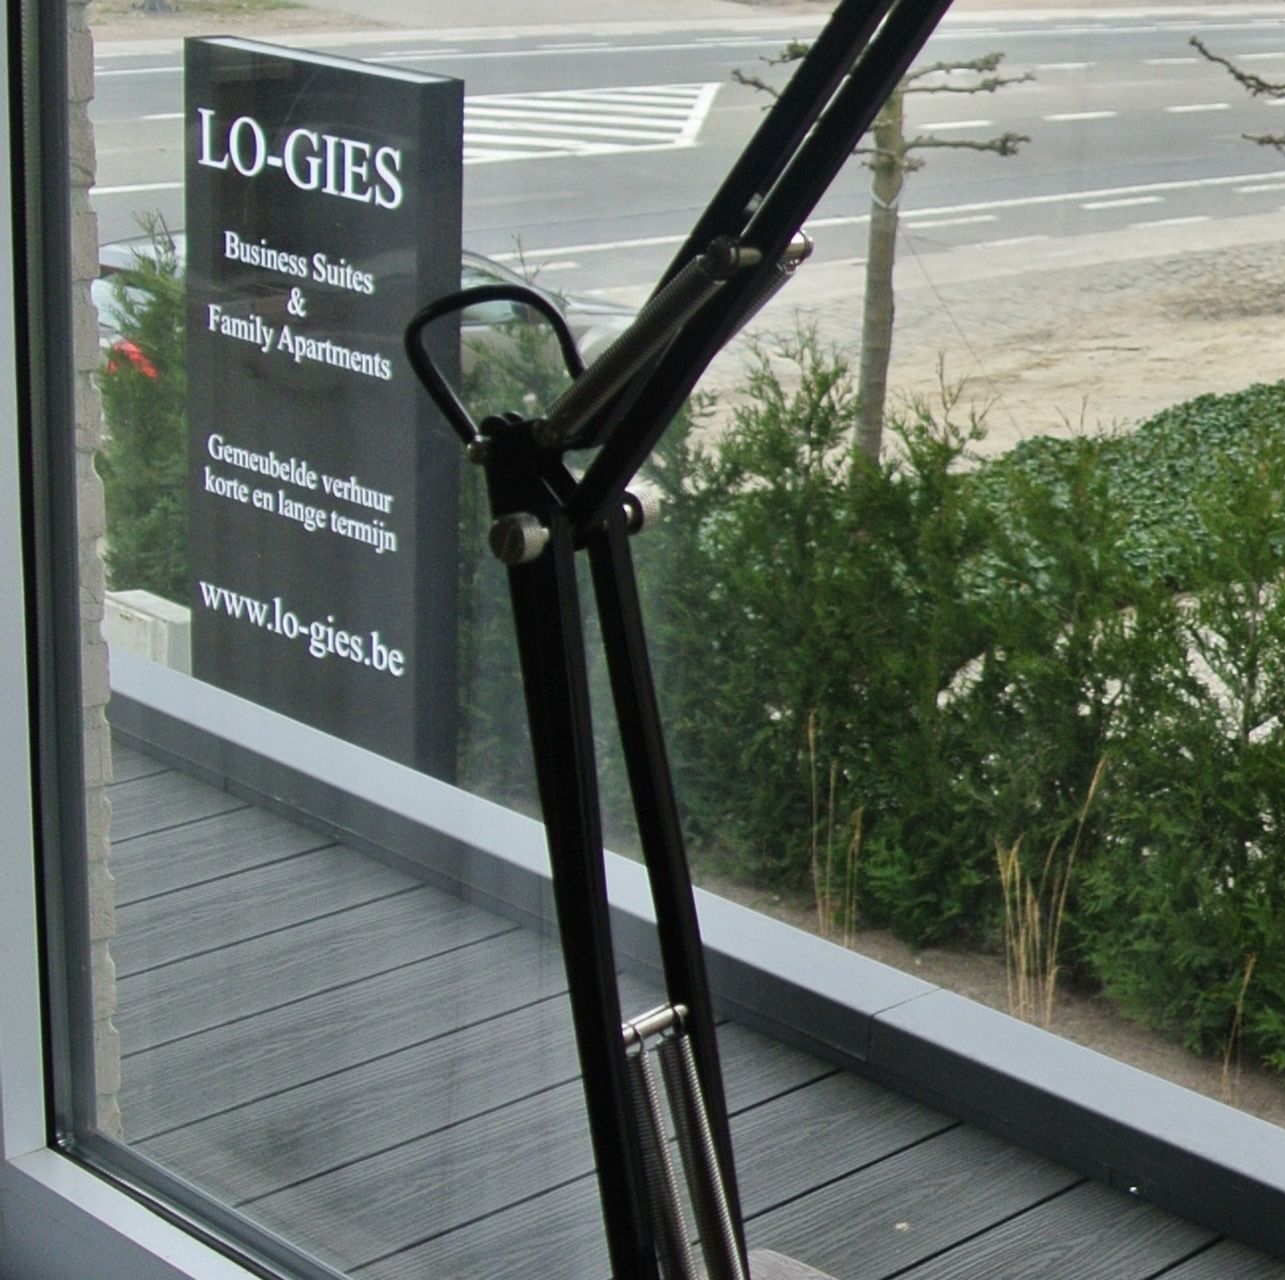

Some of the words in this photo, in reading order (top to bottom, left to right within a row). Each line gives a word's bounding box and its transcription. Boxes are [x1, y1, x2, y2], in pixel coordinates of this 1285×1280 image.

[198, 107, 403, 210] LO-GIES
[224, 230, 307, 278] Business
[312, 252, 375, 295] Suites
[286, 286, 307, 317] &
[208, 303, 274, 353] Family
[277, 325, 392, 381] Apartments
[204, 466, 249, 503] korte
[252, 488, 274, 512] en
[278, 489, 327, 532] lange
[330, 510, 397, 554] termijn
[207, 433, 318, 491] Gemeubelde
[321, 474, 394, 514] verhuur
[199, 581, 404, 677] www.lo-gies.be
